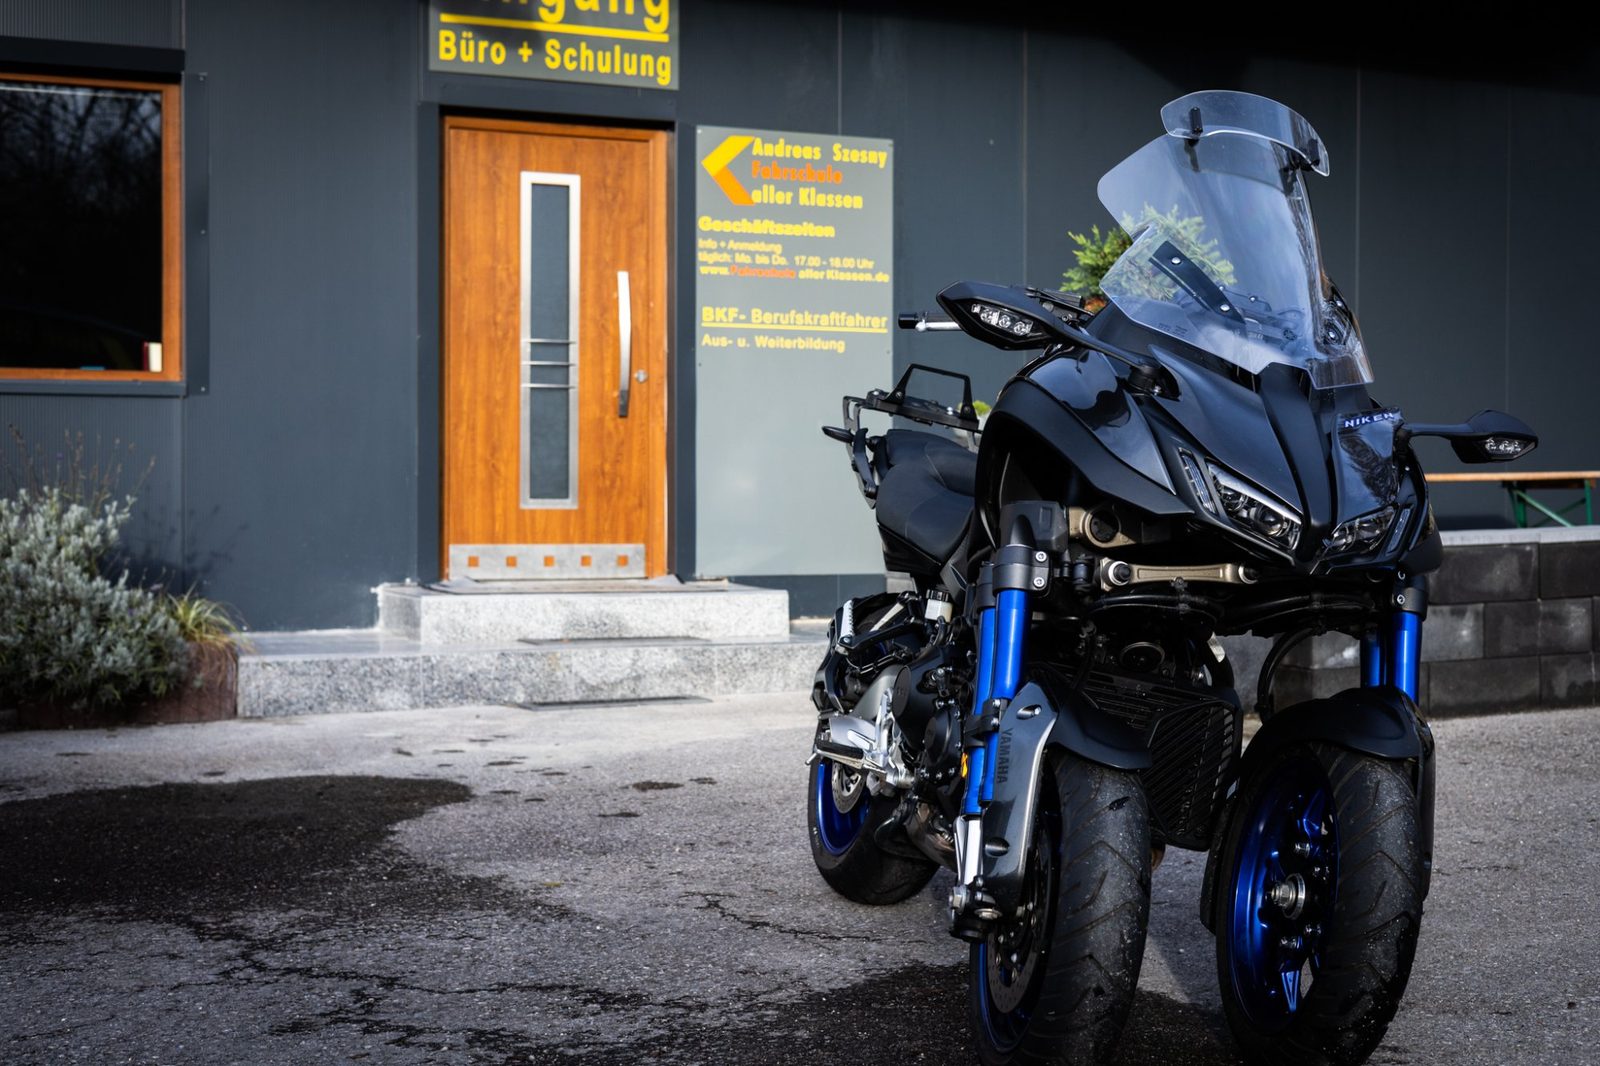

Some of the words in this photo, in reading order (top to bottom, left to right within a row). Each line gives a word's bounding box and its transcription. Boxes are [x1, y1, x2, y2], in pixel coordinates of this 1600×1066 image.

[438, 29, 507, 65] Büro
[518, 41, 533, 63] +
[544, 38, 672, 86] Schulung
[752, 137, 822, 160] Andreas
[752, 160, 843, 185] Fahrschule
[752, 184, 794, 205] aller
[799, 187, 864, 209] Klassen
[698, 215, 836, 238] Geschäftszeiten
[702, 306, 746, 323] BKF-
[751, 308, 888, 328] Berufskraftfahrer
[702, 334, 733, 348] Aus-
[755, 335, 846, 354] Weiterbildung
[1344, 412, 1394, 428] NIKEN
[997, 727, 1013, 784] YAMAHA
